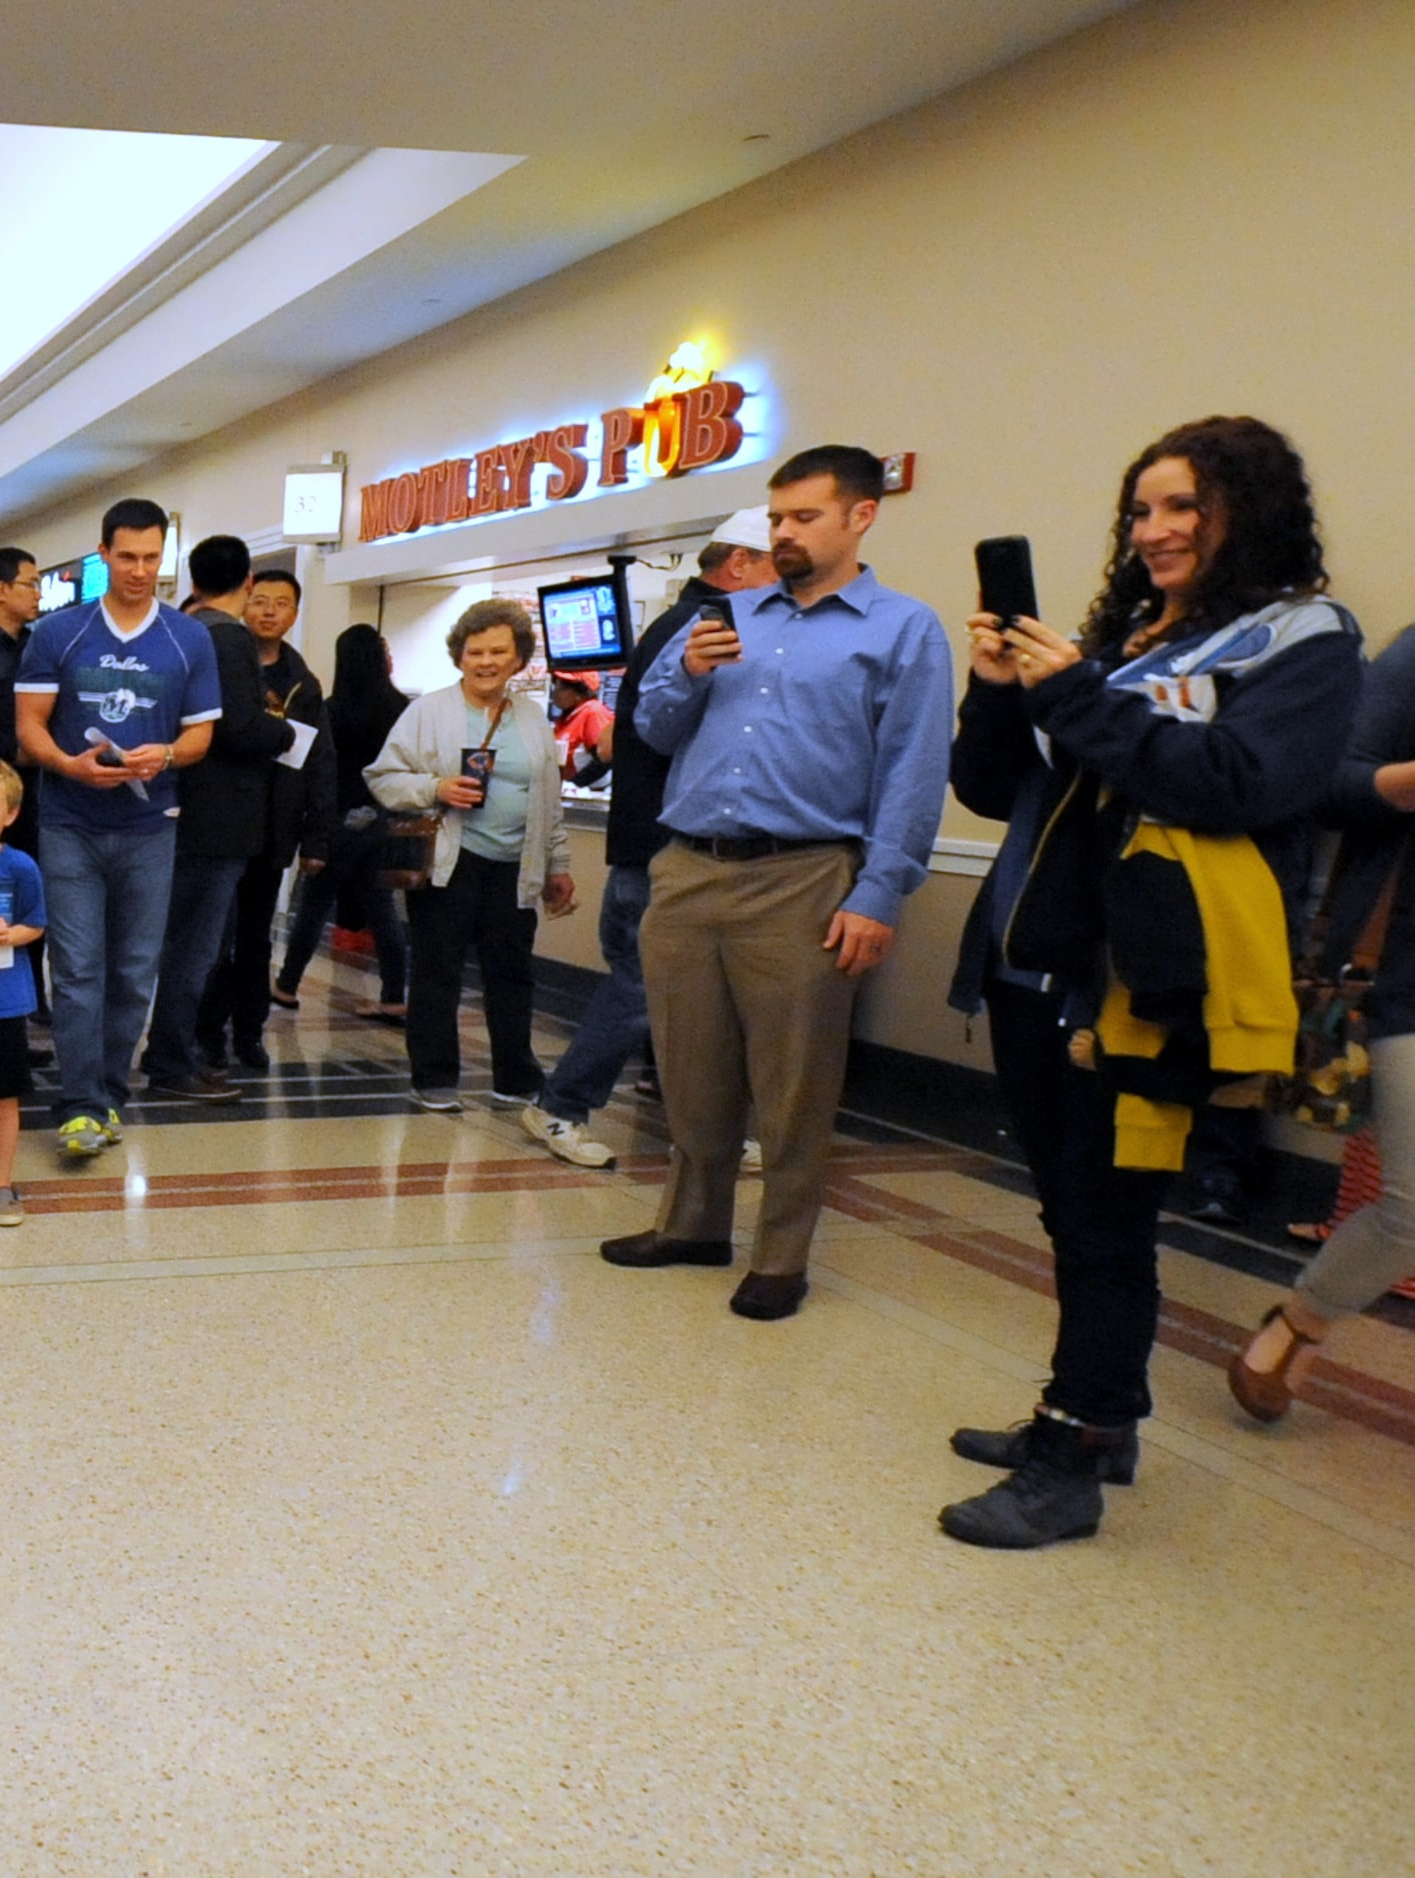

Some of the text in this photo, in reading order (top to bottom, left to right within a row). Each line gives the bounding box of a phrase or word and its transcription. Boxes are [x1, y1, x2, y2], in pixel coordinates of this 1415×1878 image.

[359, 381, 745, 542] MOTLEY'S PUB
[99, 654, 149, 672] Dallas
